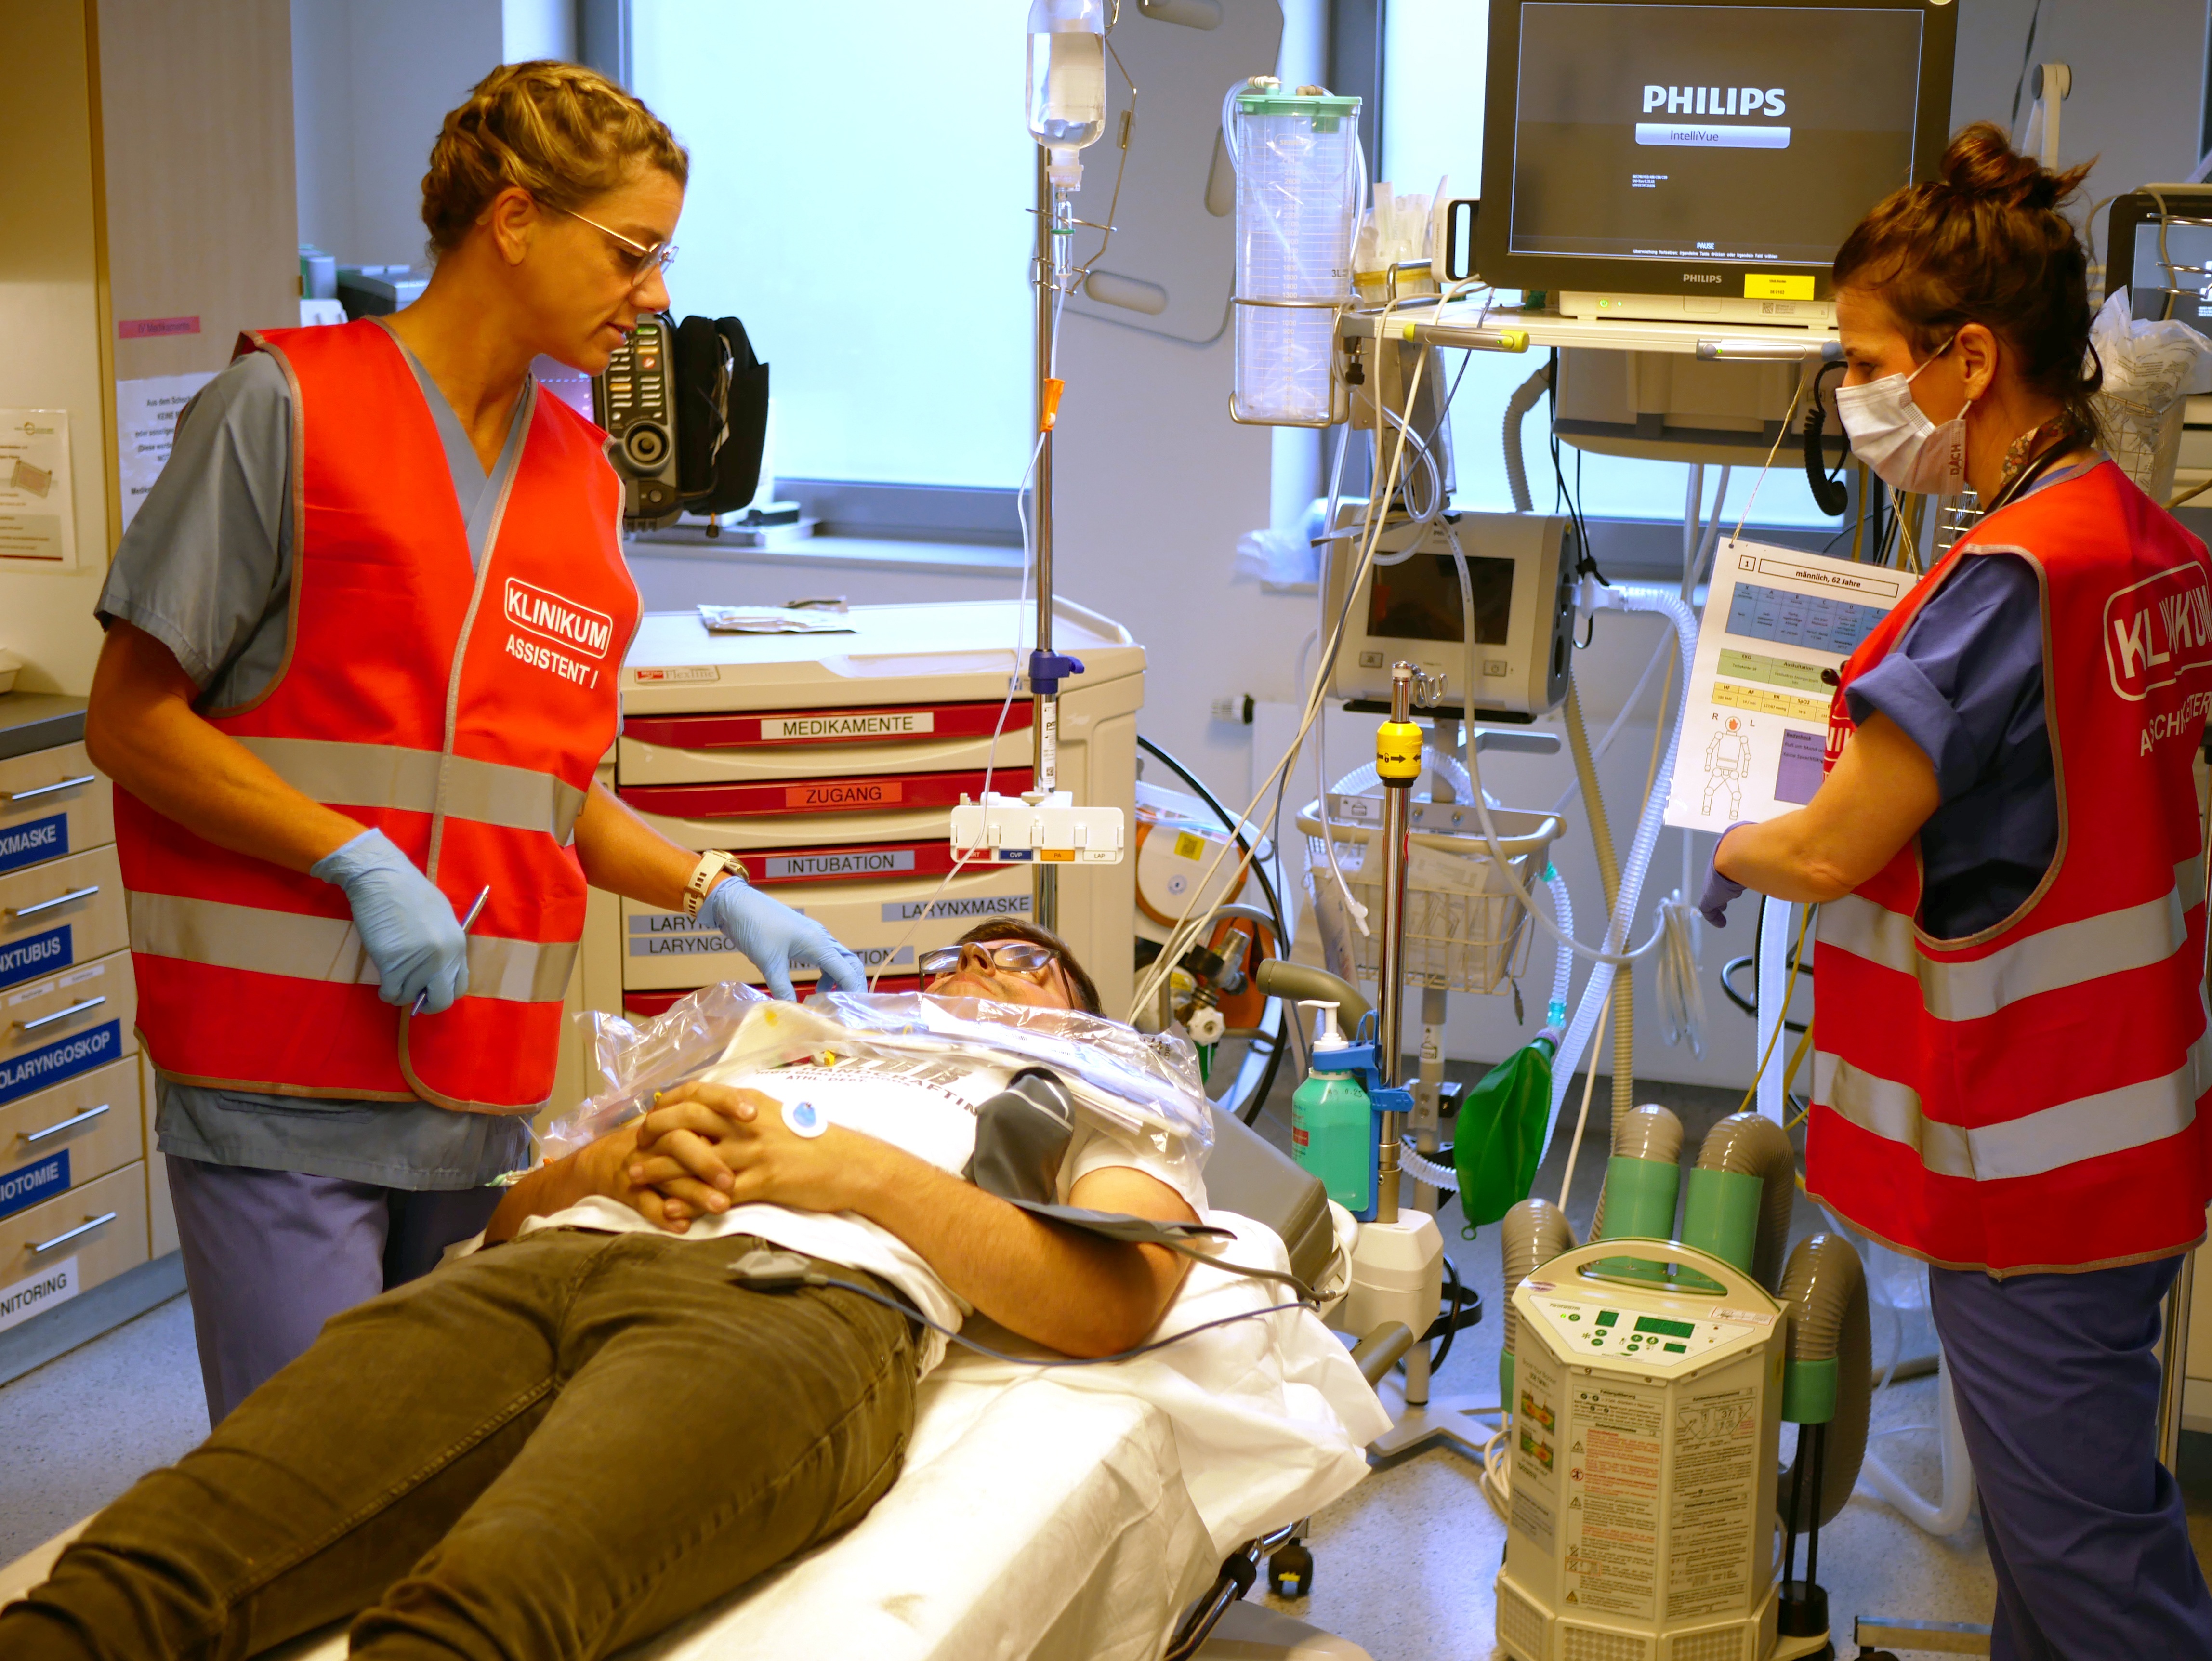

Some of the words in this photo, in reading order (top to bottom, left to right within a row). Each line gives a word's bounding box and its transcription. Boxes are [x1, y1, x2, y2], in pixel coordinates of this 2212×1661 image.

[1643, 85, 1786, 117] PHILIPS
[1670, 130, 1719, 142] IntelliVue
[1683, 274, 1722, 283] PHILIPS
[1796, 571, 1830, 583] männlich,
[1842, 578, 1861, 588] Jahre
[508, 587, 608, 650] KLINIKUM
[506, 634, 591, 685] ASSISTENT
[1784, 662, 1813, 671] Auskultation
[783, 715, 913, 736] MEDIKAMENTE
[1787, 732, 1811, 741] Bodycheck
[806, 786, 882, 804] ZUGANG
[788, 855, 894, 873] INTUBATION
[902, 897, 1030, 919] LARYNXMASKE
[1721, 1411, 1733, 1419] 37
